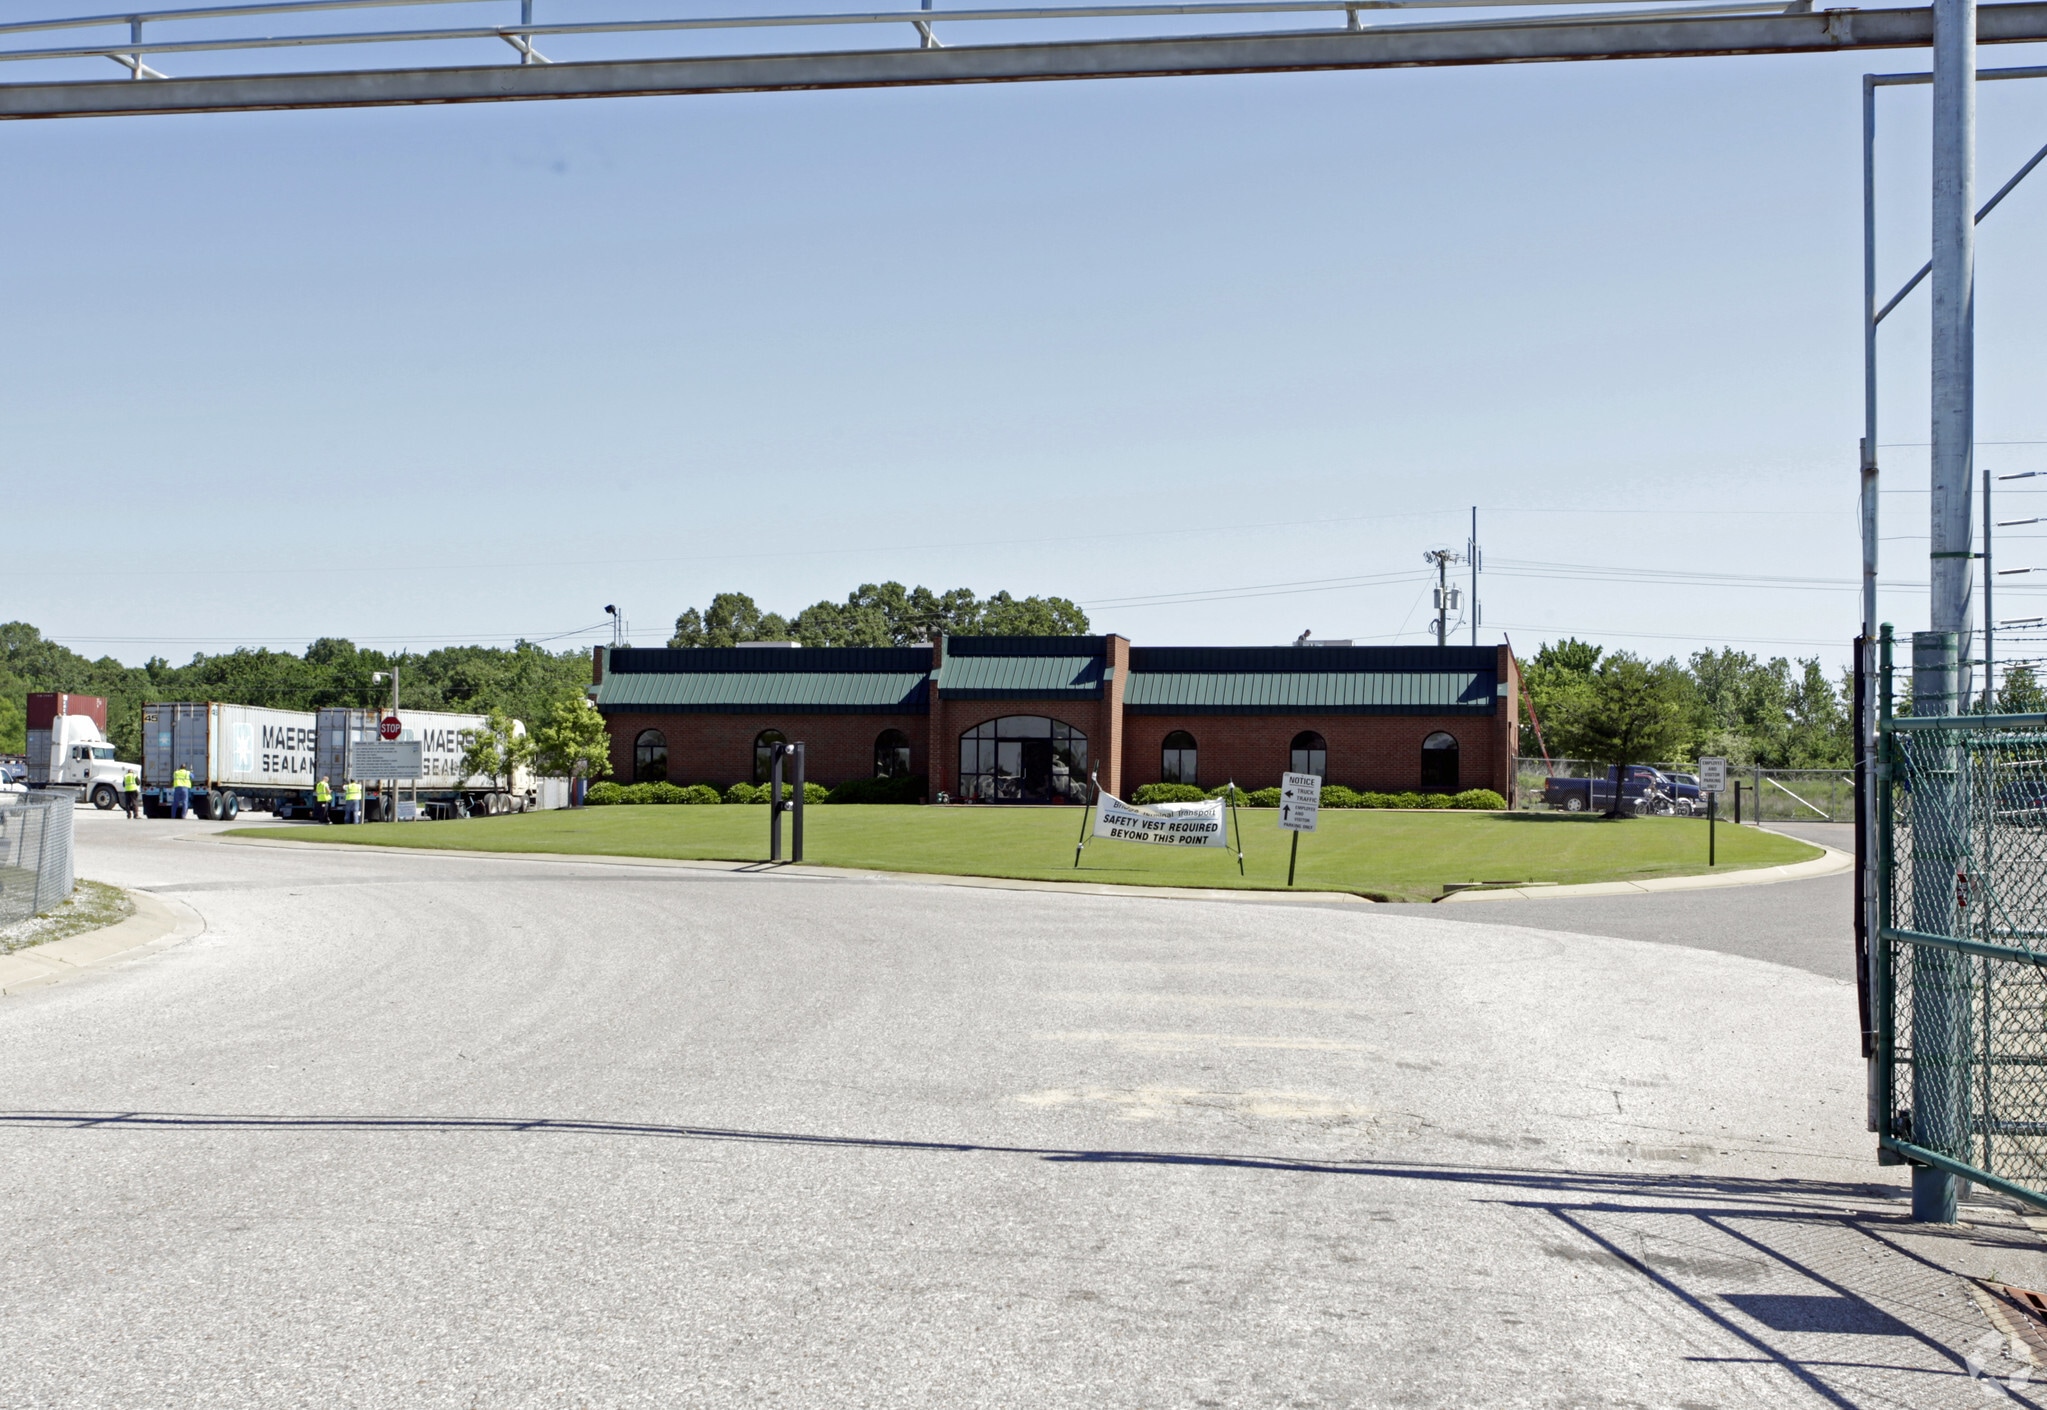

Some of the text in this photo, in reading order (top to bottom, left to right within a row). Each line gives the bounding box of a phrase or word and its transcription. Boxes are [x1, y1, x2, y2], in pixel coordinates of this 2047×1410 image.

[381, 724, 401, 733] STOP
[1290, 776, 1315, 786] NOTICE
[1103, 814, 1218, 832] SAFETY VEST REQUIRED
[1110, 828, 1209, 845] BEYOND THIS POINT
